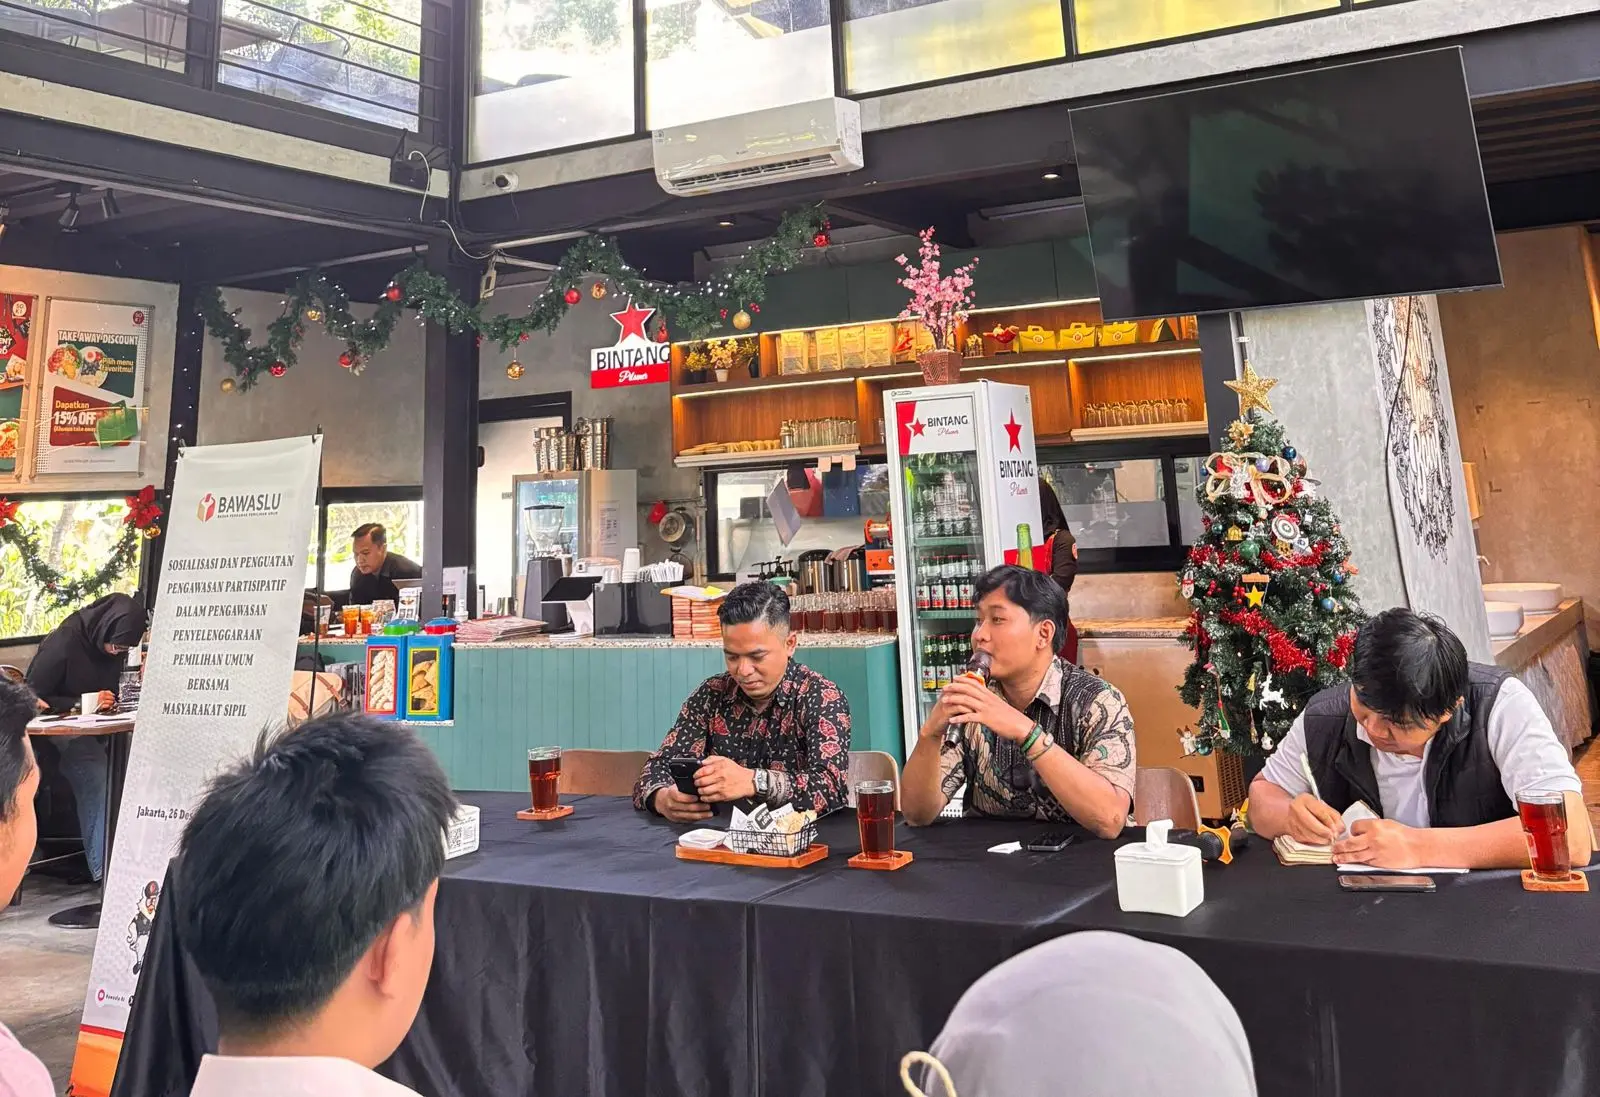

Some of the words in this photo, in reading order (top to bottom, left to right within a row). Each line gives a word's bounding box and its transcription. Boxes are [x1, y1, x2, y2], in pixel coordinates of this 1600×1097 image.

[58, 330, 78, 341] TAKE
[79, 332, 101, 343] AWAY
[102, 334, 139, 345] DISCOUNT
[102, 357, 116, 366] Pilih
[55, 400, 90, 410] Dapatkan
[53, 411, 78, 425] 15%
[78, 411, 97, 425] OFF
[927, 415, 969, 428] BINTANG
[999, 460, 1034, 478] BINTANG
[218, 493, 282, 513] BAWASLU
[167, 558, 219, 571] SOSIALISASI
[219, 557, 240, 569] DAN
[239, 555, 295, 568] PENGUATAN
[167, 581, 224, 594] PENGAWASAN
[225, 579, 287, 593] PARTISIPATIF
[175, 605, 207, 617] DALAM
[207, 604, 268, 617] PENGAWASAN
[172, 628, 263, 641] PENYELENGGARAAN
[172, 653, 223, 666] PEMILIHAN
[224, 653, 254, 666] UMUM
[186, 678, 230, 691] BERSAMA
[162, 702, 223, 716] MASYARAKAT
[223, 703, 248, 717] SIPIL
[136, 805, 168, 821] Jakarta,
[168, 808, 178, 819] 26
